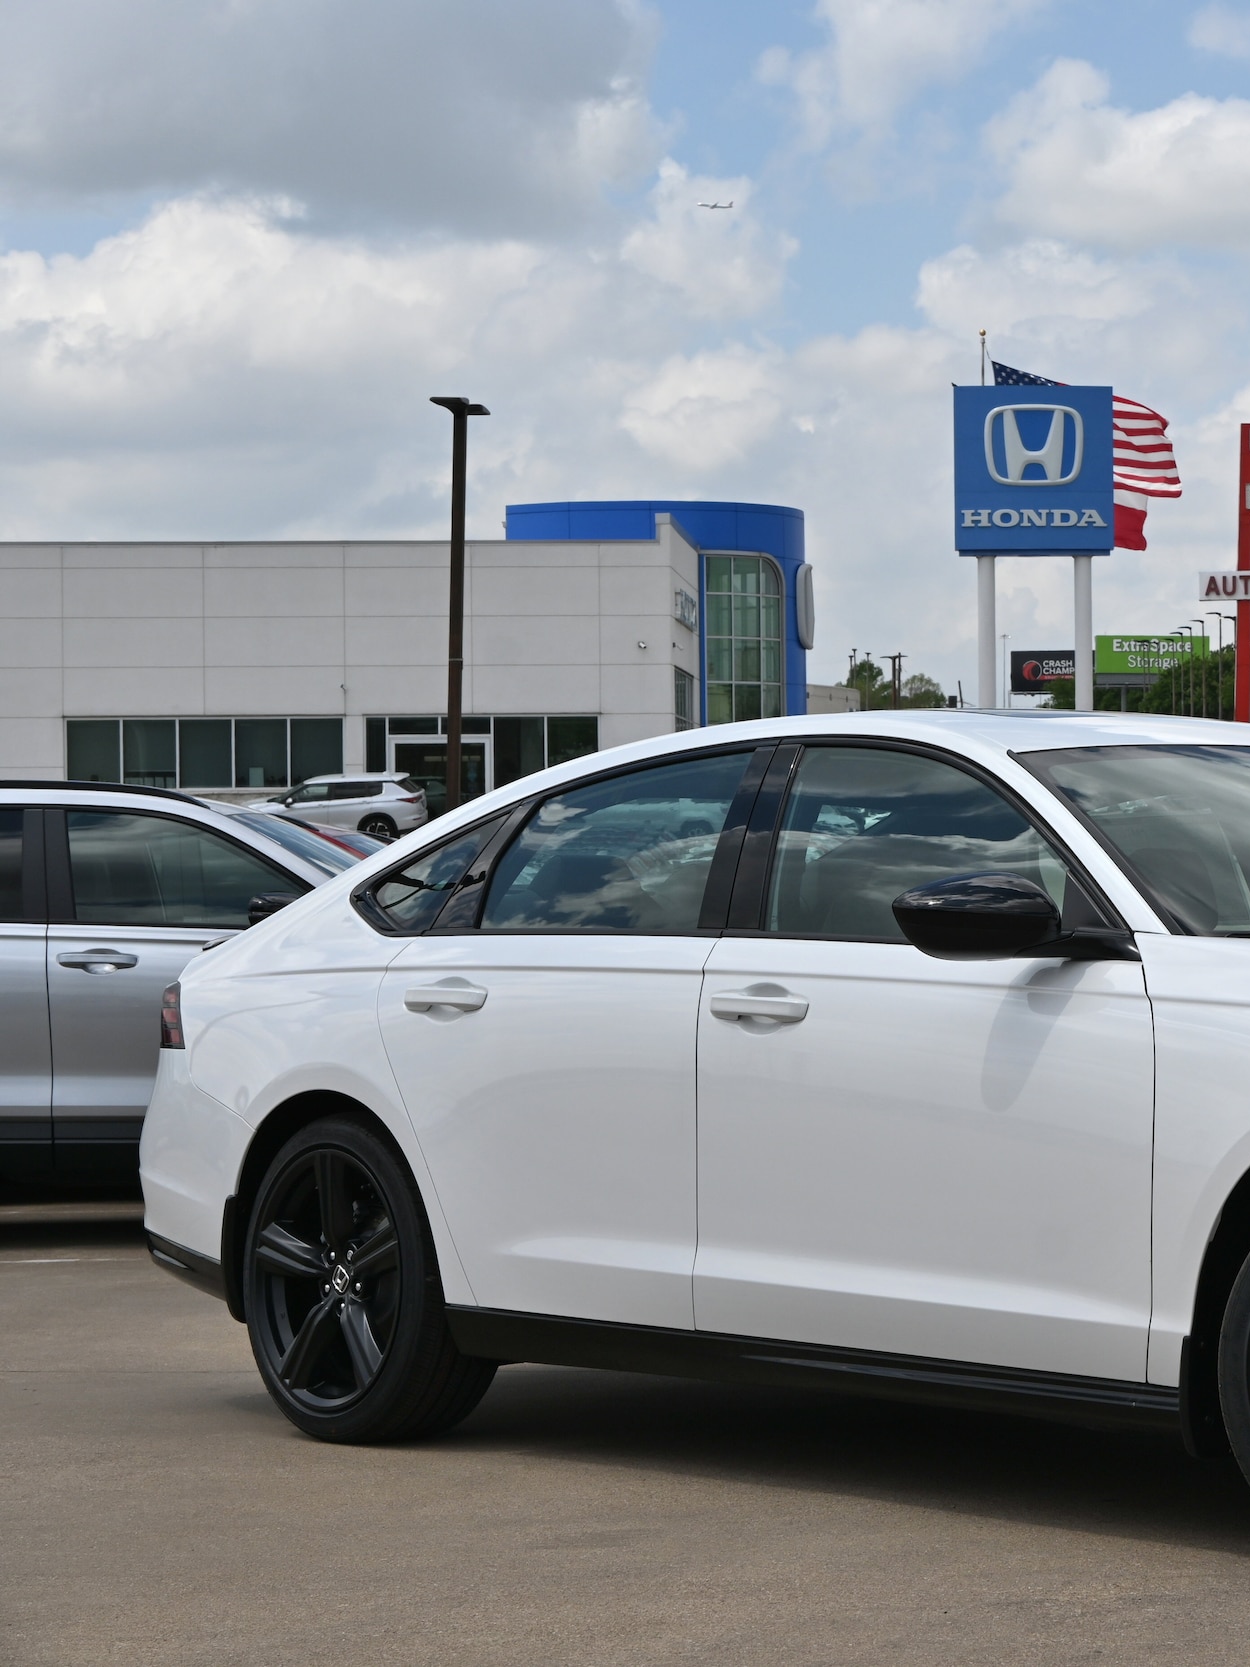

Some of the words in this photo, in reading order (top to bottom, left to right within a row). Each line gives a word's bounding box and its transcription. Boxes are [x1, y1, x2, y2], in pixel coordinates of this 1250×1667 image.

[961, 508, 1108, 528] HONDA
[1043, 660, 1073, 668] CRASH
[1128, 654, 1178, 669] Storage
